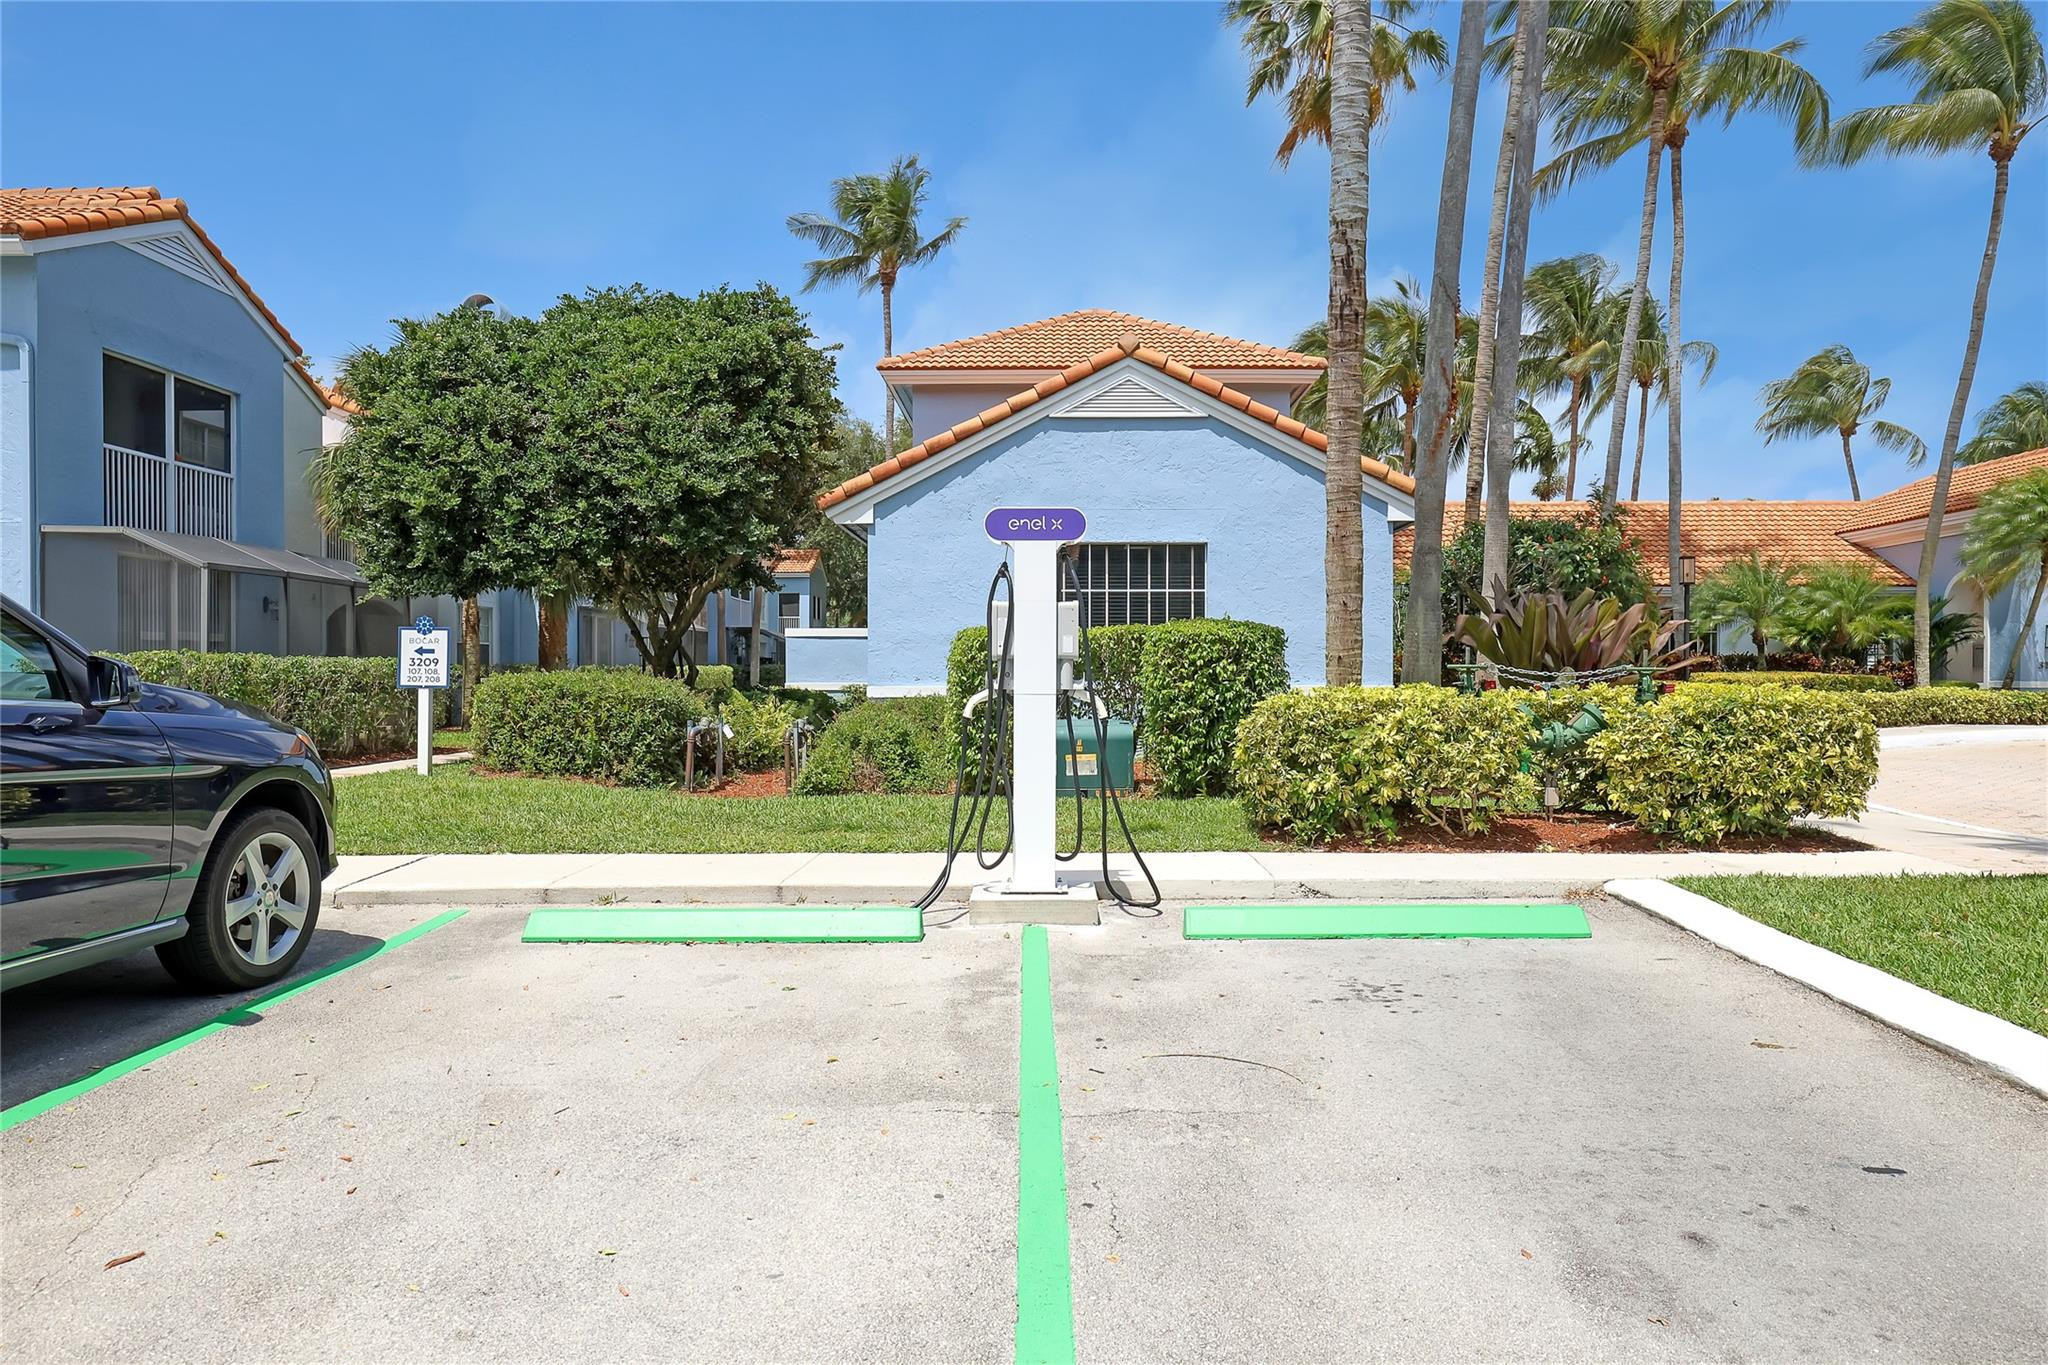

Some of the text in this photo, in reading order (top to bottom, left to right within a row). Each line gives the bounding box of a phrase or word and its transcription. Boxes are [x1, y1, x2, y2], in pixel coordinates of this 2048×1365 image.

[1008, 515, 1063, 531] enel x
[408, 637, 440, 645] BOCAR
[408, 657, 440, 667] 3209
